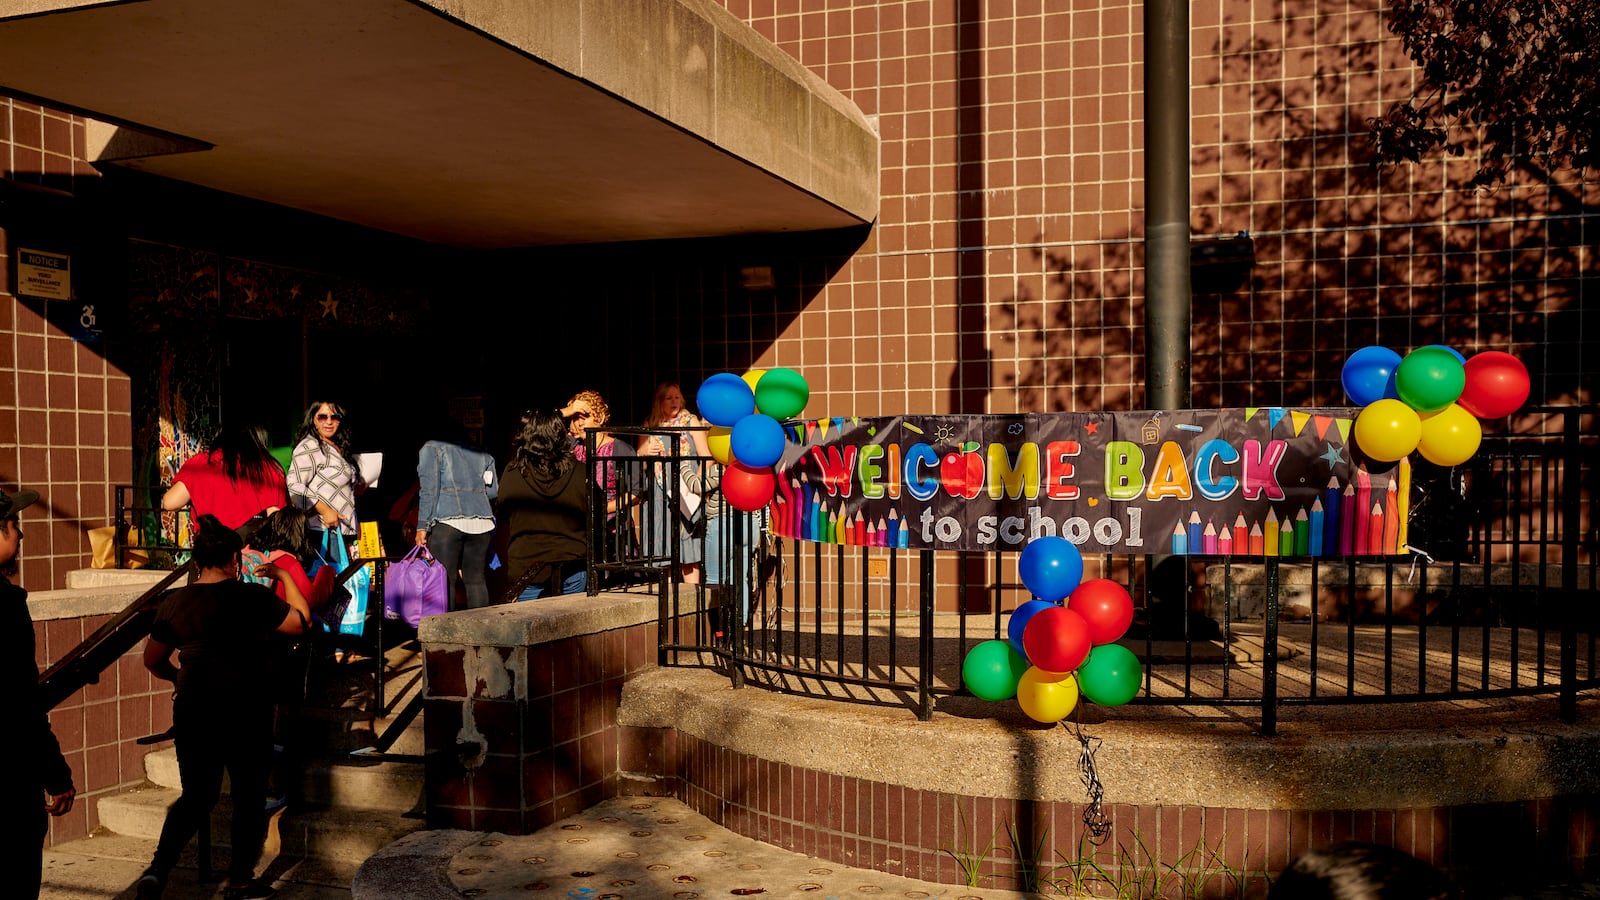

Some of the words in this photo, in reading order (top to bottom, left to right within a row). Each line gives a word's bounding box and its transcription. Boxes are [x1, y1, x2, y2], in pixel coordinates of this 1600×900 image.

[28, 255, 60, 267] NOTICE
[1104, 438, 1288, 501] BACK
[920, 506, 962, 543] to
[977, 506, 1144, 547] school
